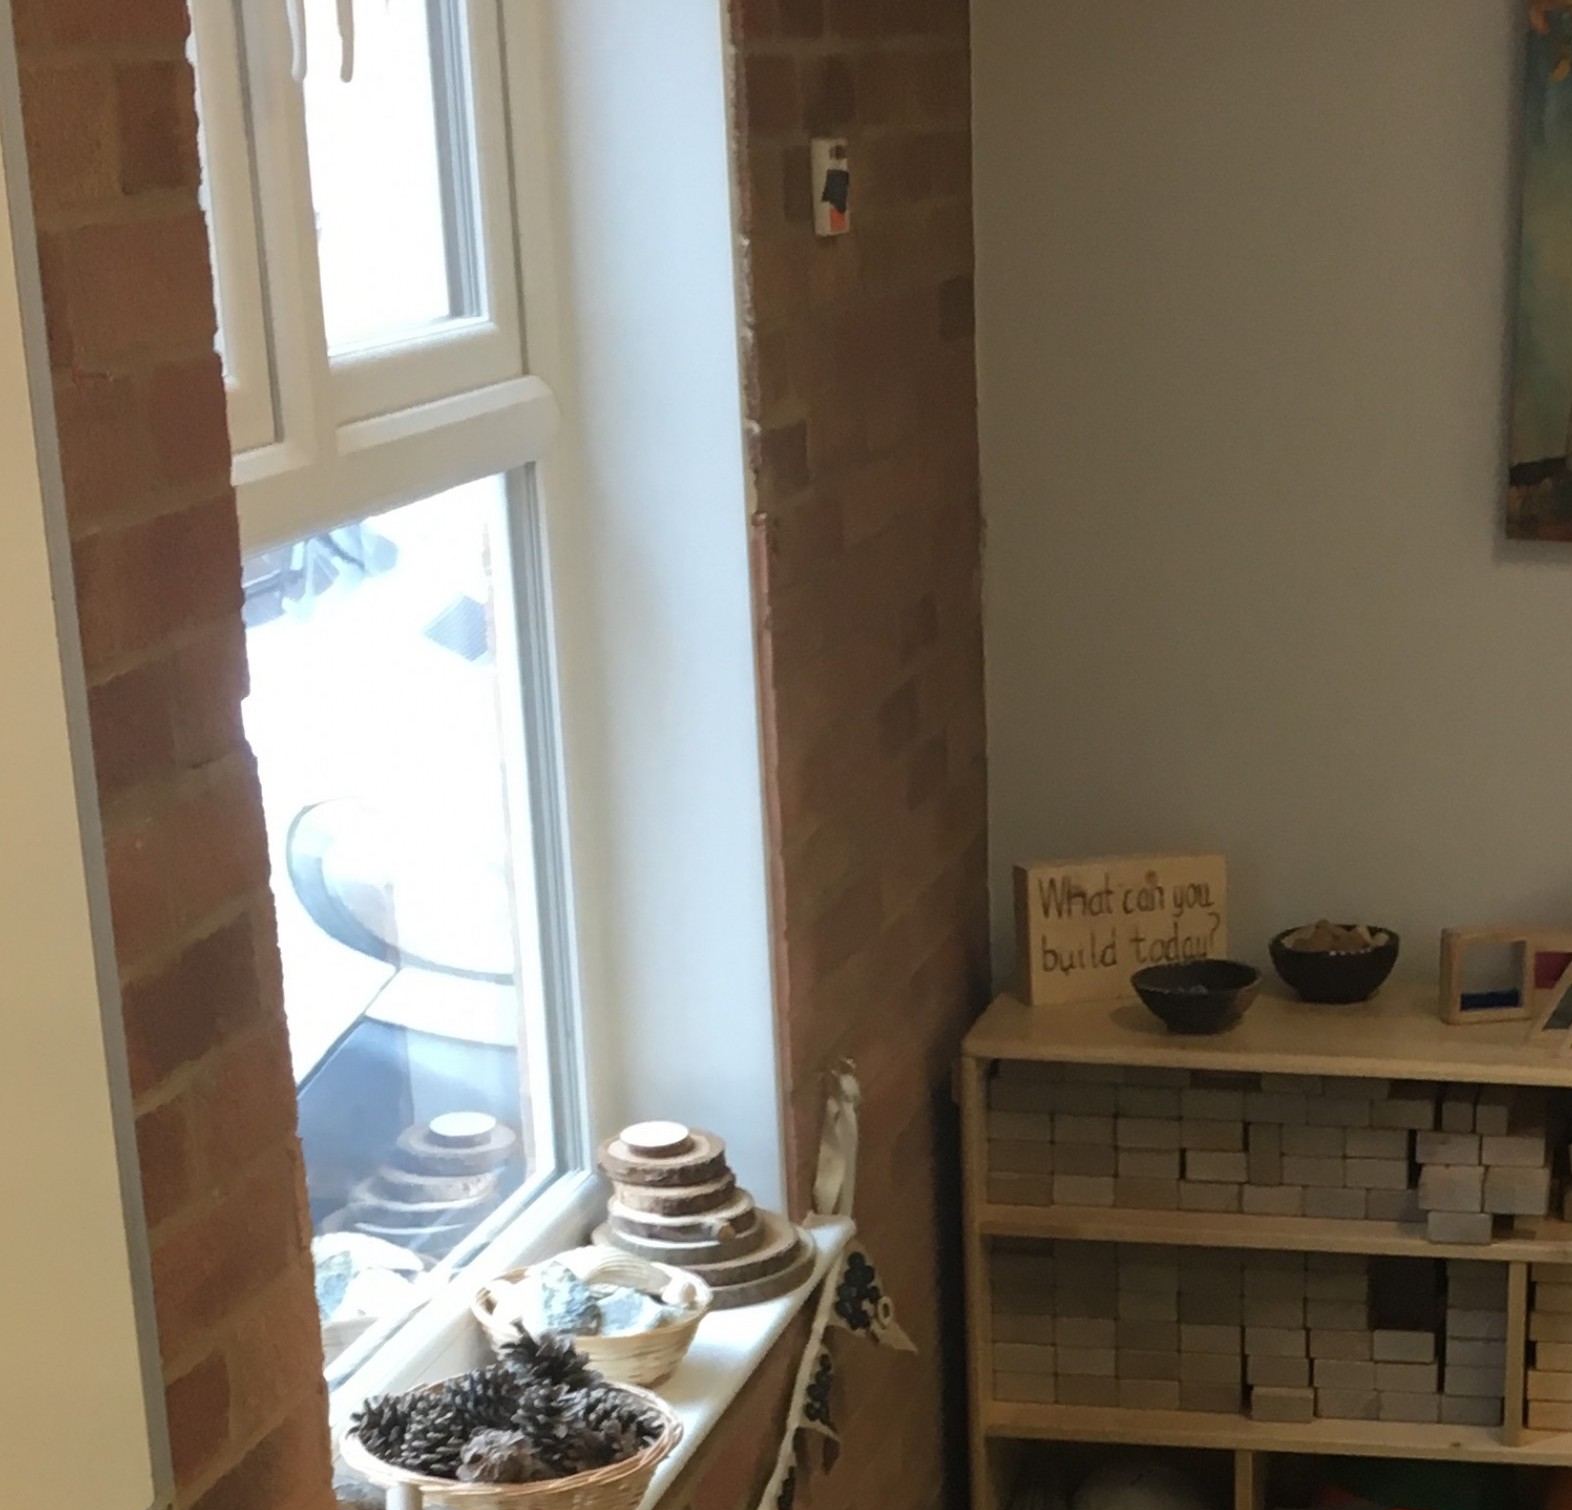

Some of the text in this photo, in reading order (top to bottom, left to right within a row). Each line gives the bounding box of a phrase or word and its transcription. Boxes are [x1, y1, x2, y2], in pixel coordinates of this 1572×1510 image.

[1039, 873, 1215, 919] What can you
[1042, 928, 1117, 975] build
